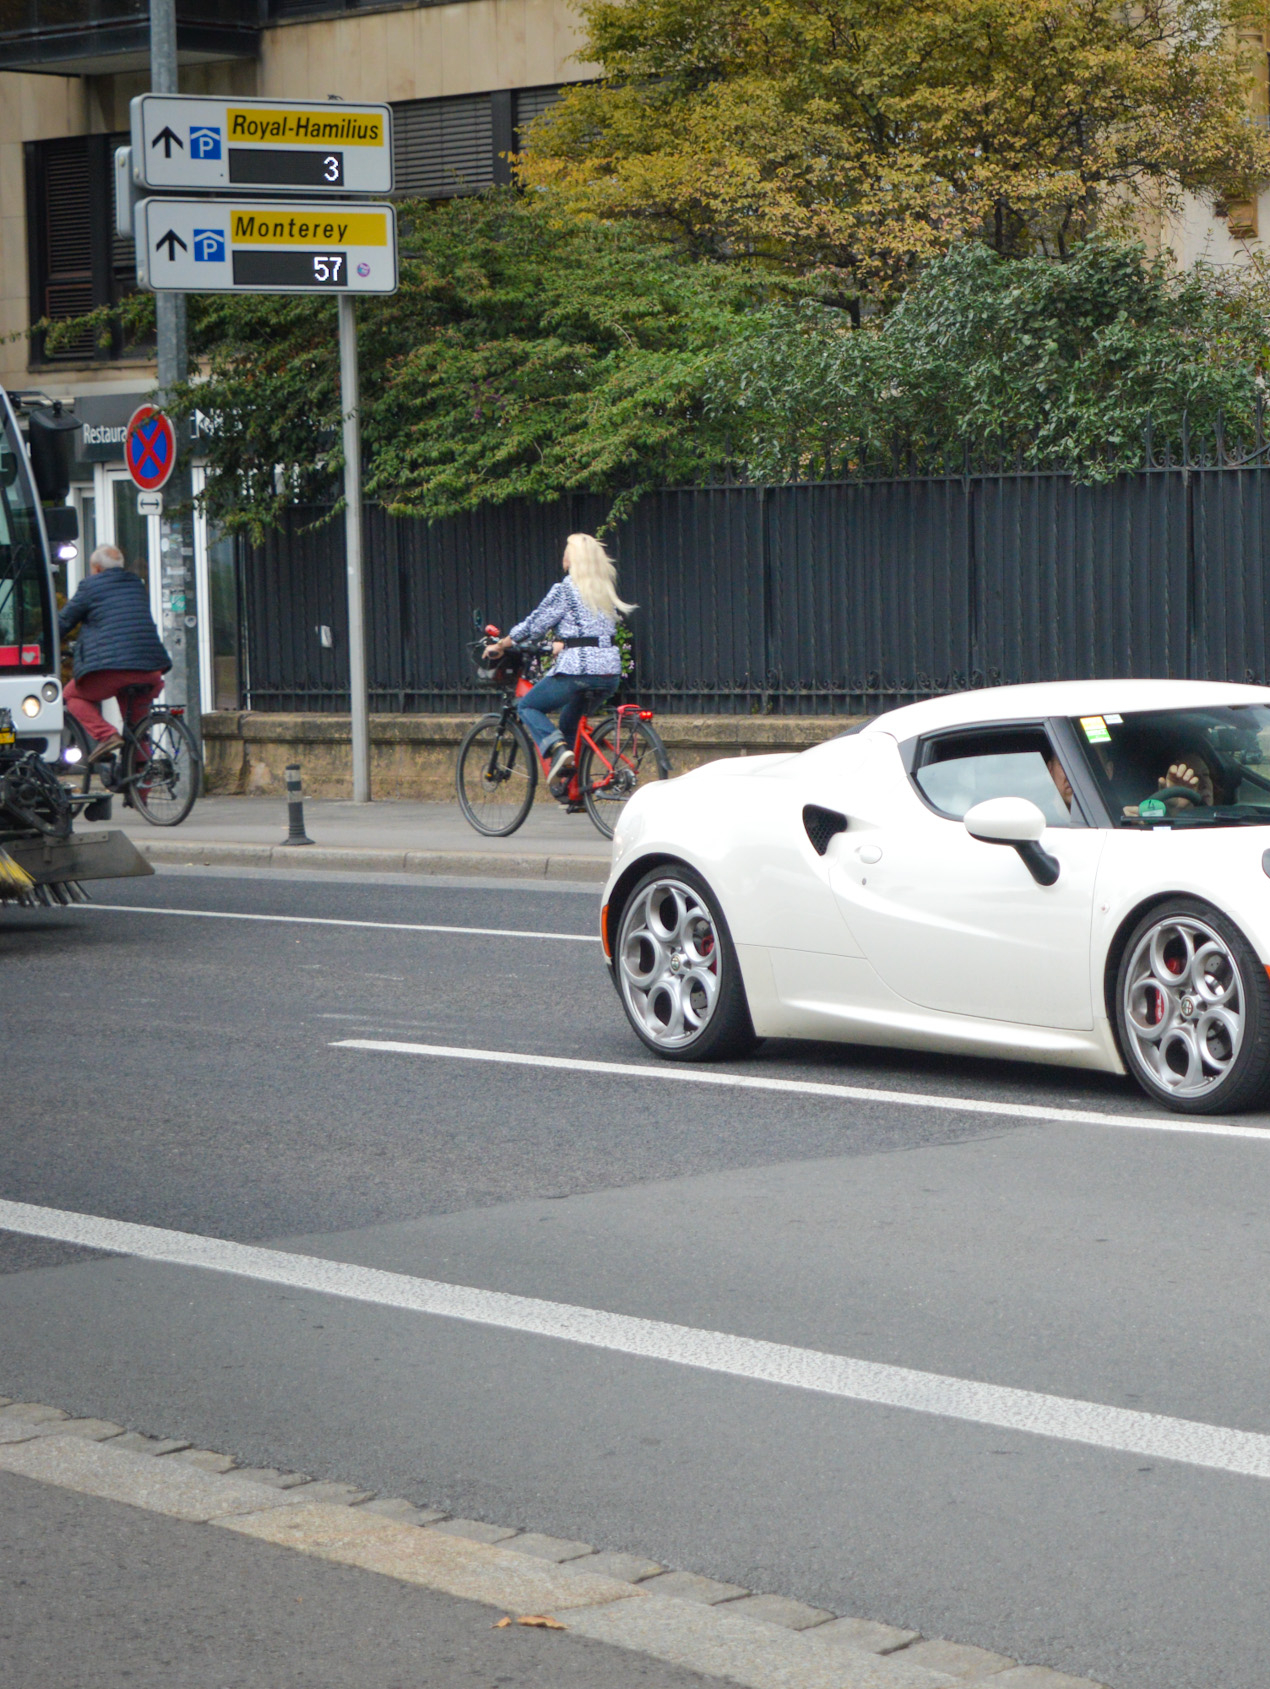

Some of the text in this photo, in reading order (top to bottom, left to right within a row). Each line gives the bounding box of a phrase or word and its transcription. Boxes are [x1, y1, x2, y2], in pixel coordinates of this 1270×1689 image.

[232, 114, 379, 140] Royal-Hamilius
[199, 137, 214, 158] P
[323, 156, 339, 182] 3
[235, 216, 348, 243] Monterey
[203, 239, 218, 260] P
[313, 256, 342, 282] 57
